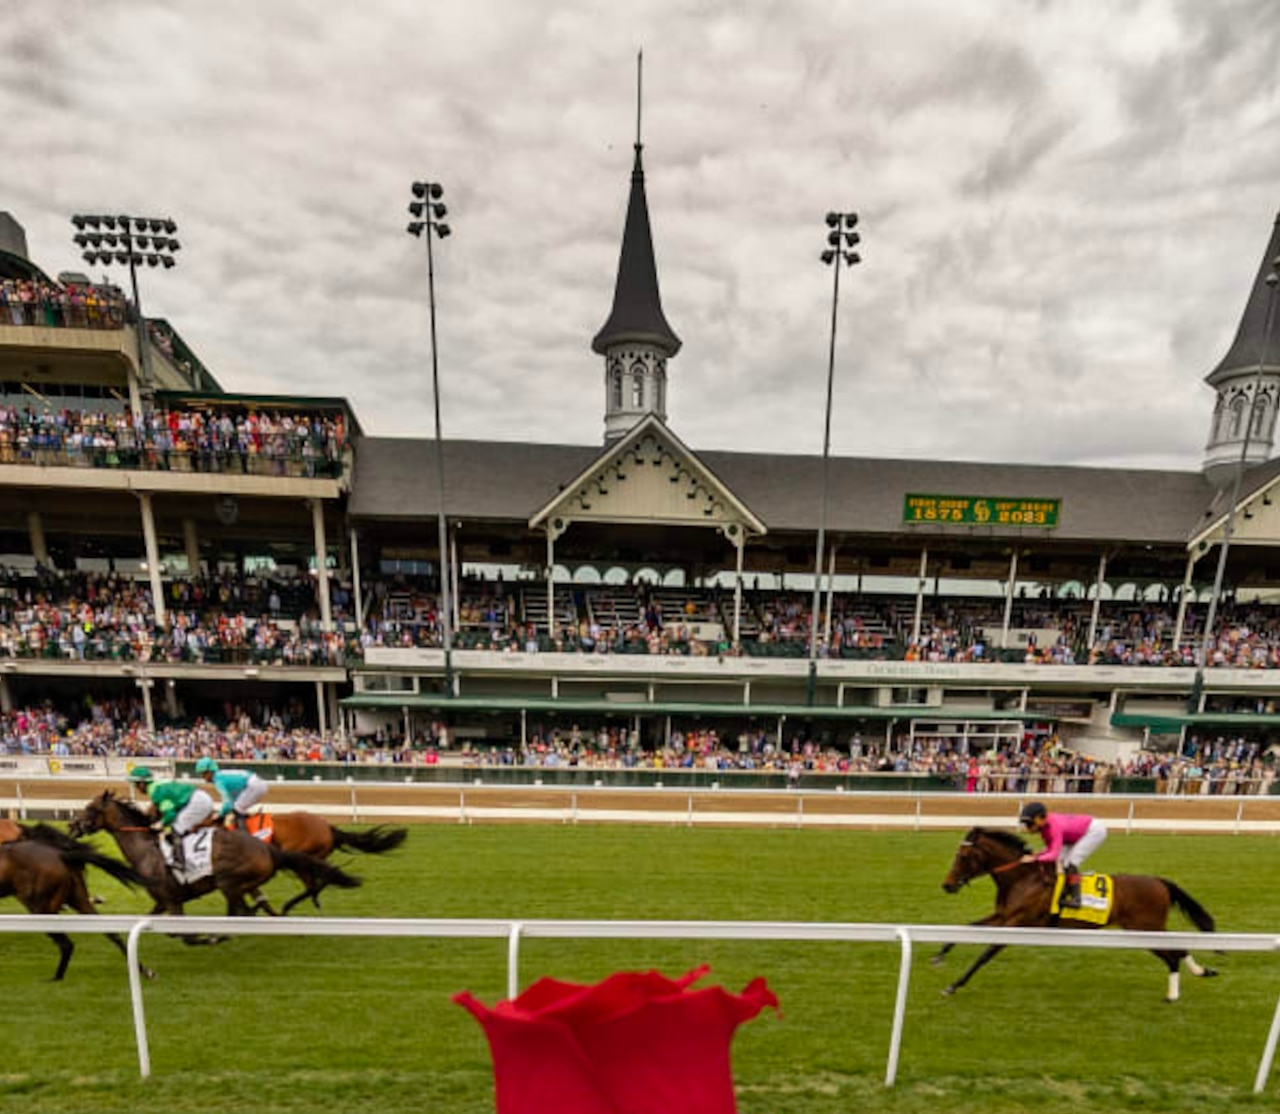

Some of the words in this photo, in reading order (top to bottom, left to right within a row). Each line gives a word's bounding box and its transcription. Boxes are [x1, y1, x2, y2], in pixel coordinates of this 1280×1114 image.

[913, 508, 963, 520] 1875
[999, 511, 1046, 523] 2023
[193, 830, 208, 852] 2
